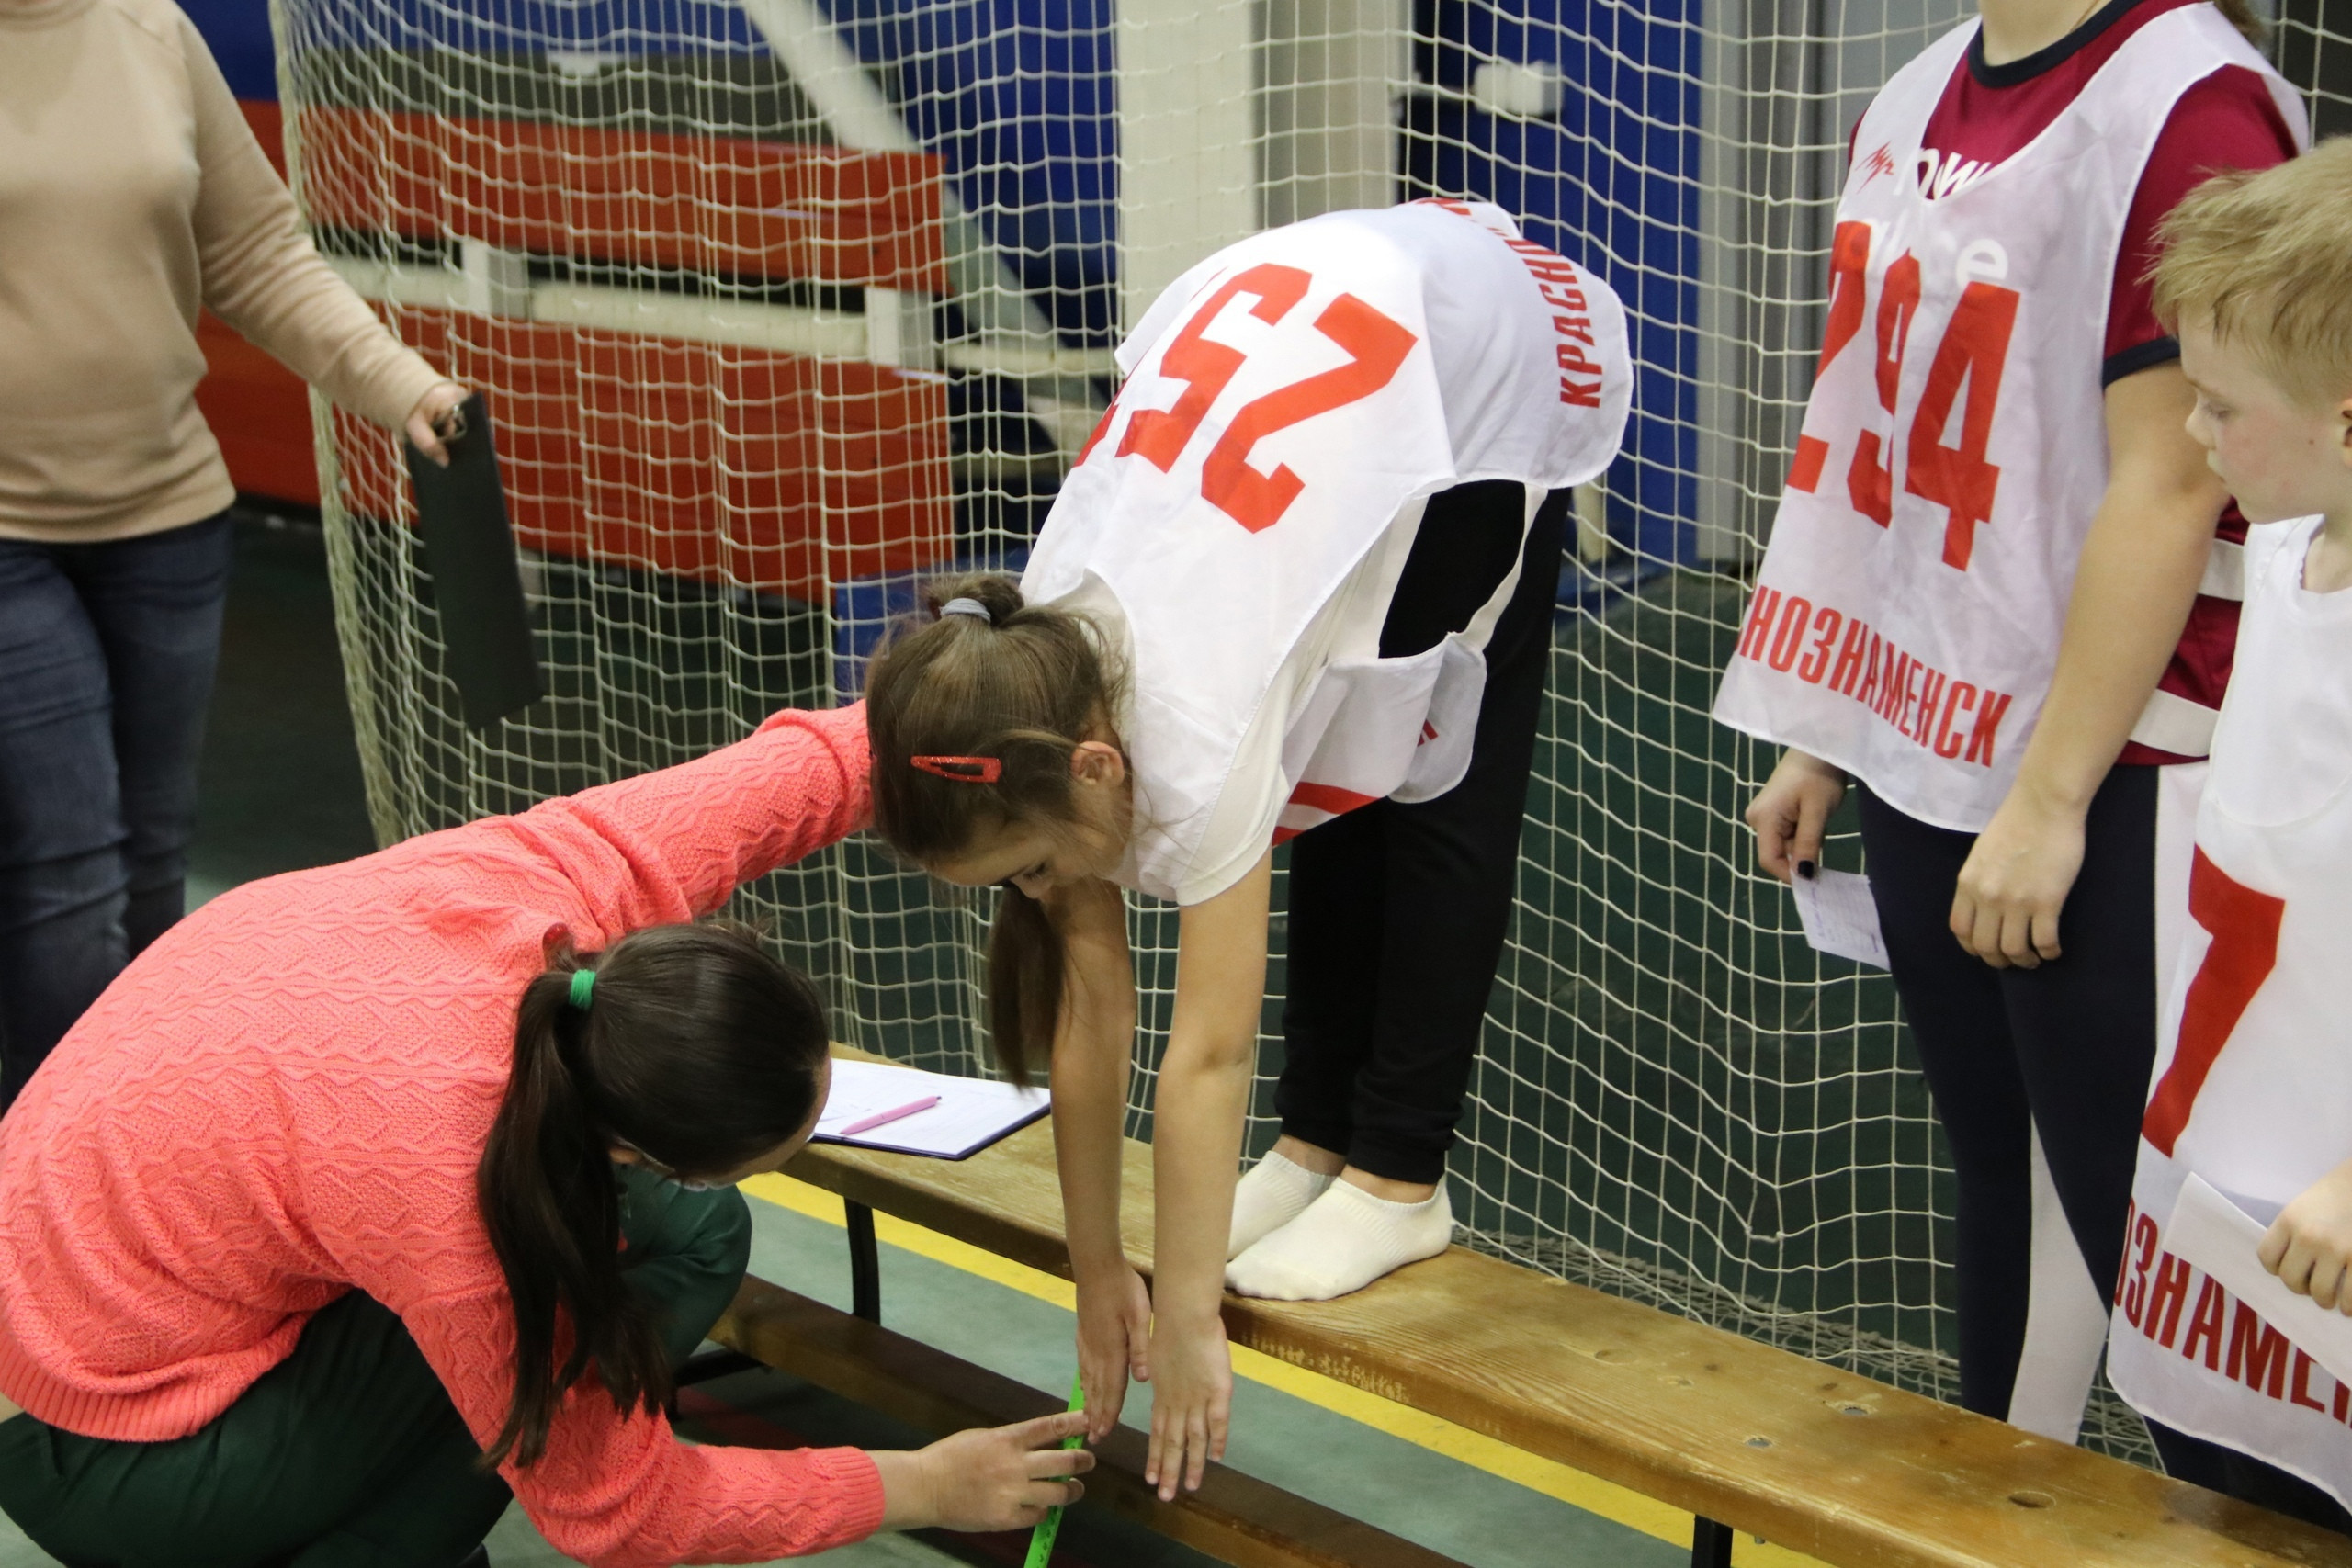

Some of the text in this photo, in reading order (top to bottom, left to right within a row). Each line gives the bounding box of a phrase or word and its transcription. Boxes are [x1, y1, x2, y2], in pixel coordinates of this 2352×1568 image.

[1070, 263, 1419, 535] 25
[1502, 239, 1603, 409] КРАСНО
[1735, 582, 2013, 768] НОЗНАМЕНСК
